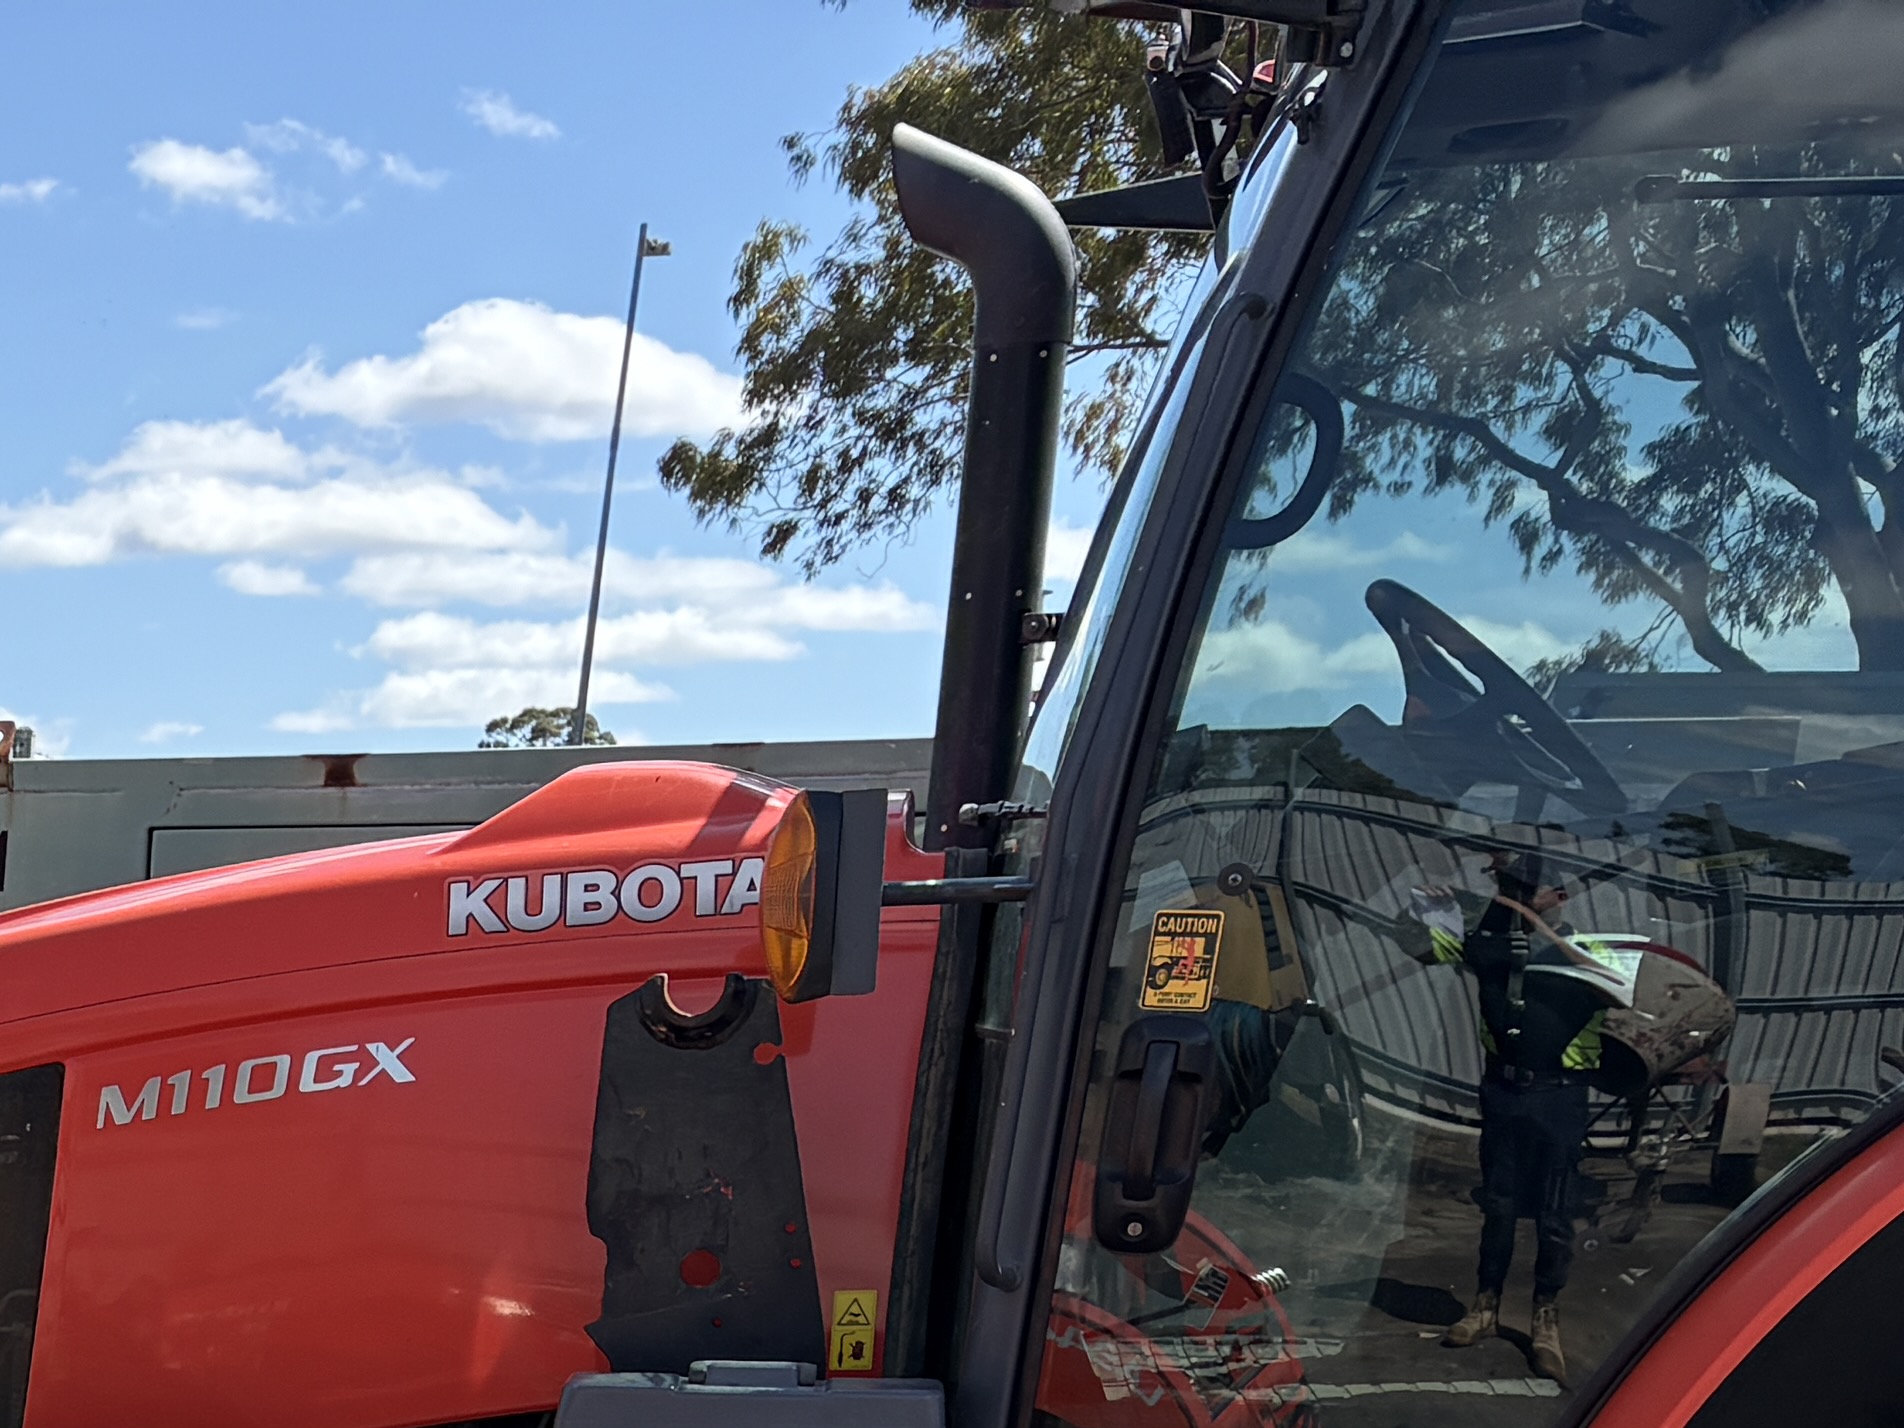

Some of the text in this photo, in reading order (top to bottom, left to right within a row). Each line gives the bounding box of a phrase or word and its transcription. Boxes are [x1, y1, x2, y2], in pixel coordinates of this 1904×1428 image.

[447, 857, 764, 937] KUBOTA
[1157, 916, 1217, 934] CAUTION
[95, 1036, 418, 1131] M110GX
